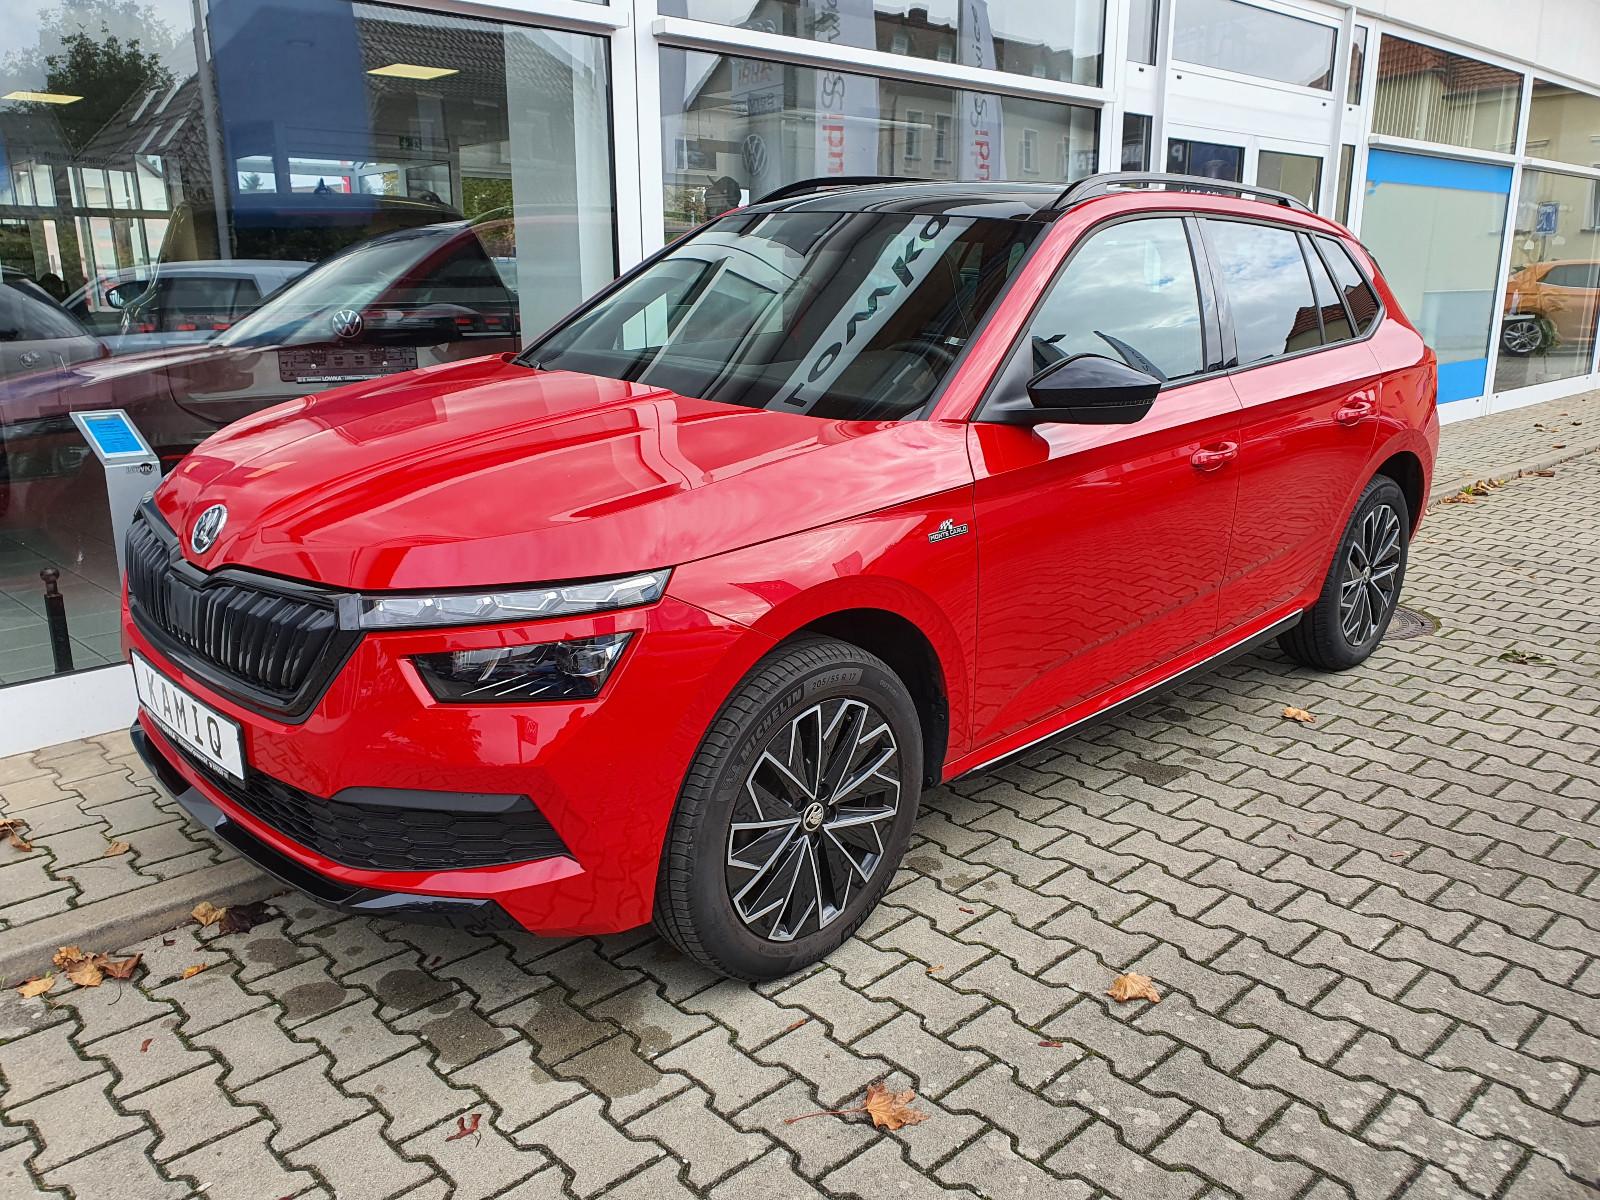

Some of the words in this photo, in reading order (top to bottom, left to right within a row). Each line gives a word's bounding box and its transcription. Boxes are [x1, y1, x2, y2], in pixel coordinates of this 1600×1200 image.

[821, 113, 845, 176] udi
[930, 530, 950, 541] MONTE
[949, 525, 967, 536] CARLO
[812, 673, 840, 691] 205/55
[145, 668, 223, 760] KAMIQ
[741, 688, 805, 762] MICHELIN
